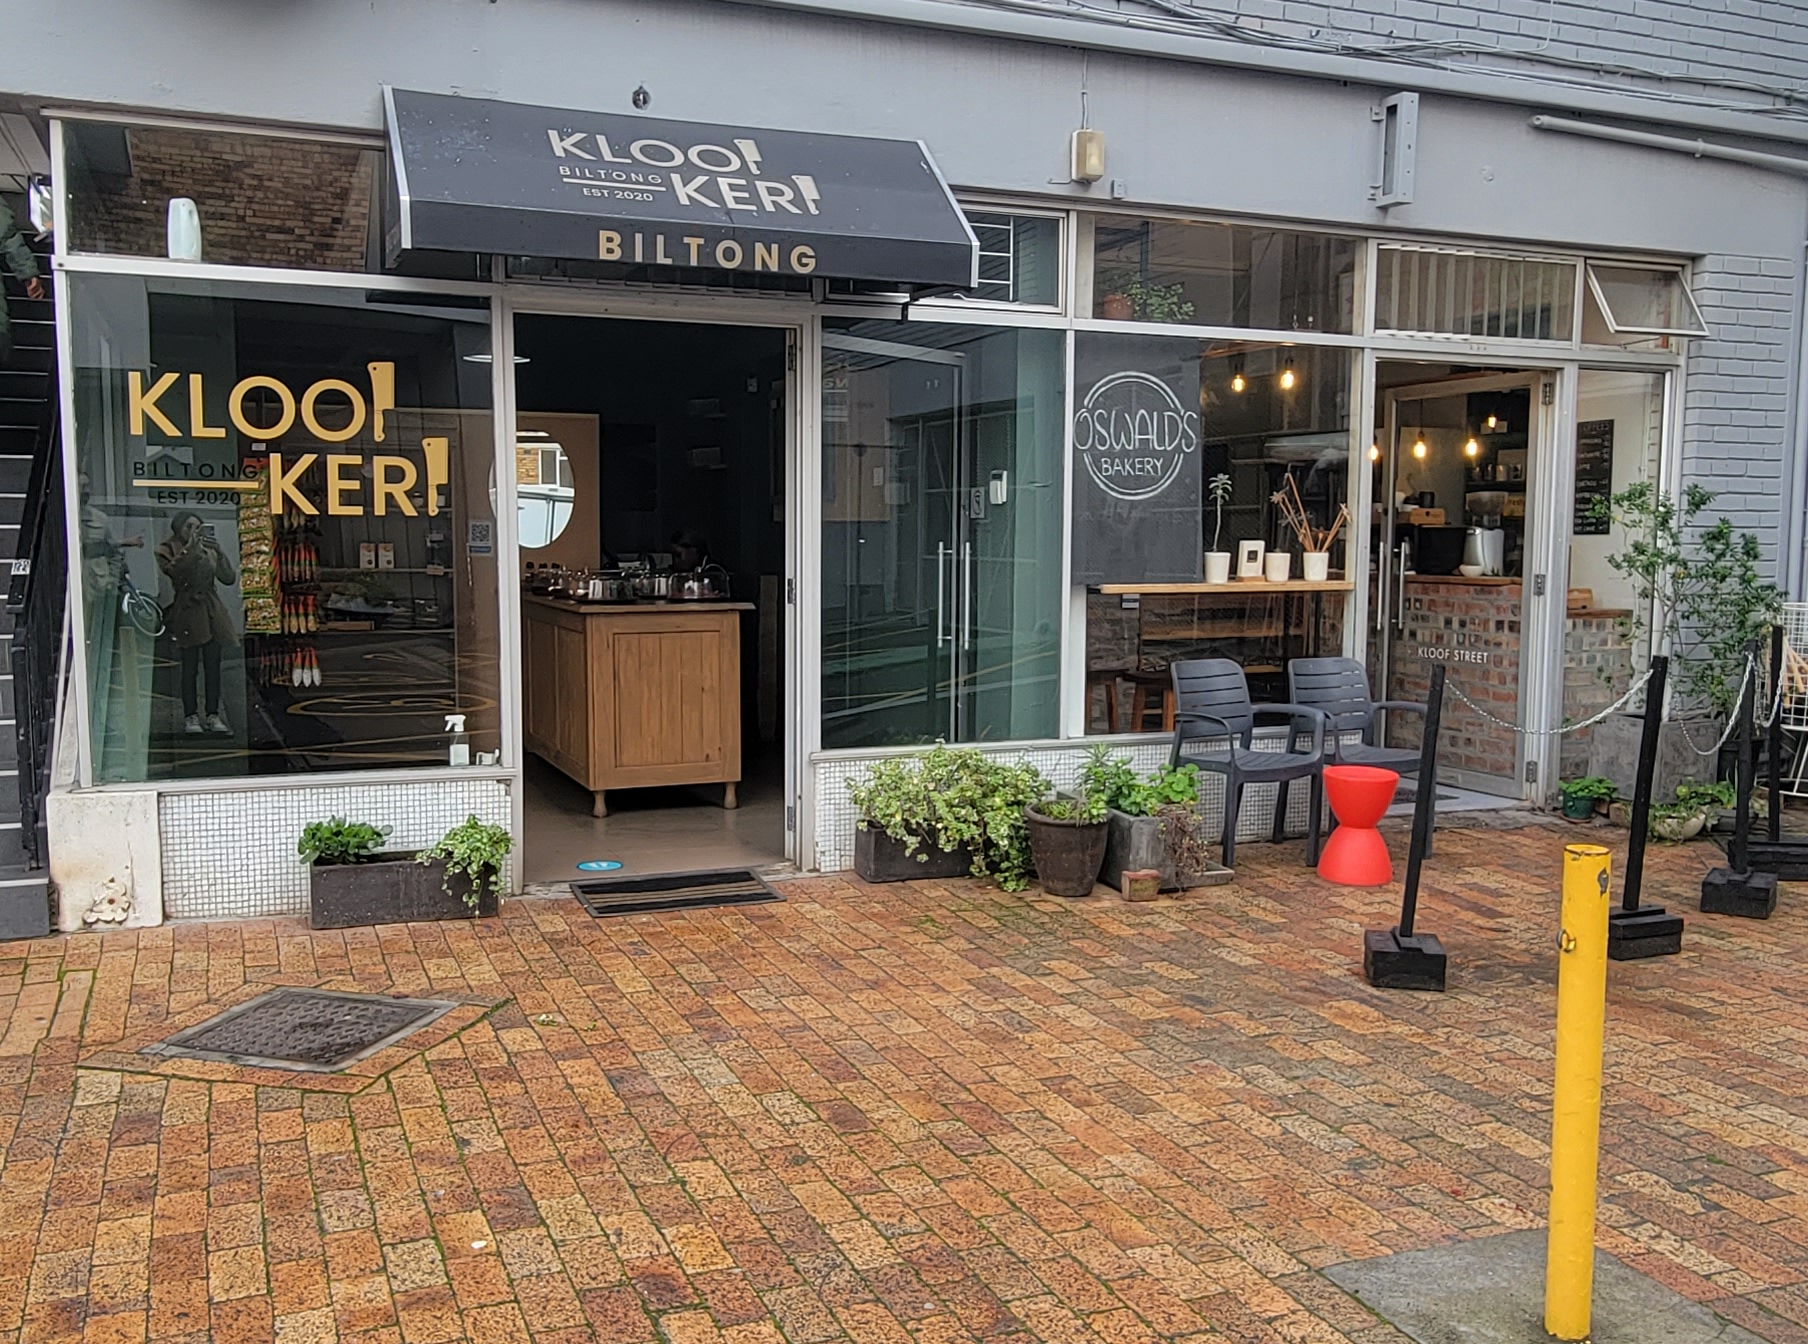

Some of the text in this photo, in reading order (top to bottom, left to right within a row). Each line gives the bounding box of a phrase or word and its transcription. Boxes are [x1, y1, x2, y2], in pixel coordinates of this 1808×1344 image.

[558, 165, 662, 185] BILTONG
[582, 187, 654, 202] EST 2020
[598, 229, 817, 274] BILTONG
[133, 461, 259, 479] BILTONG
[1100, 457, 1164, 476] BAKERY
[157, 490, 241, 506] EST 2020
[1417, 646, 1489, 664] KLOOF STREET
